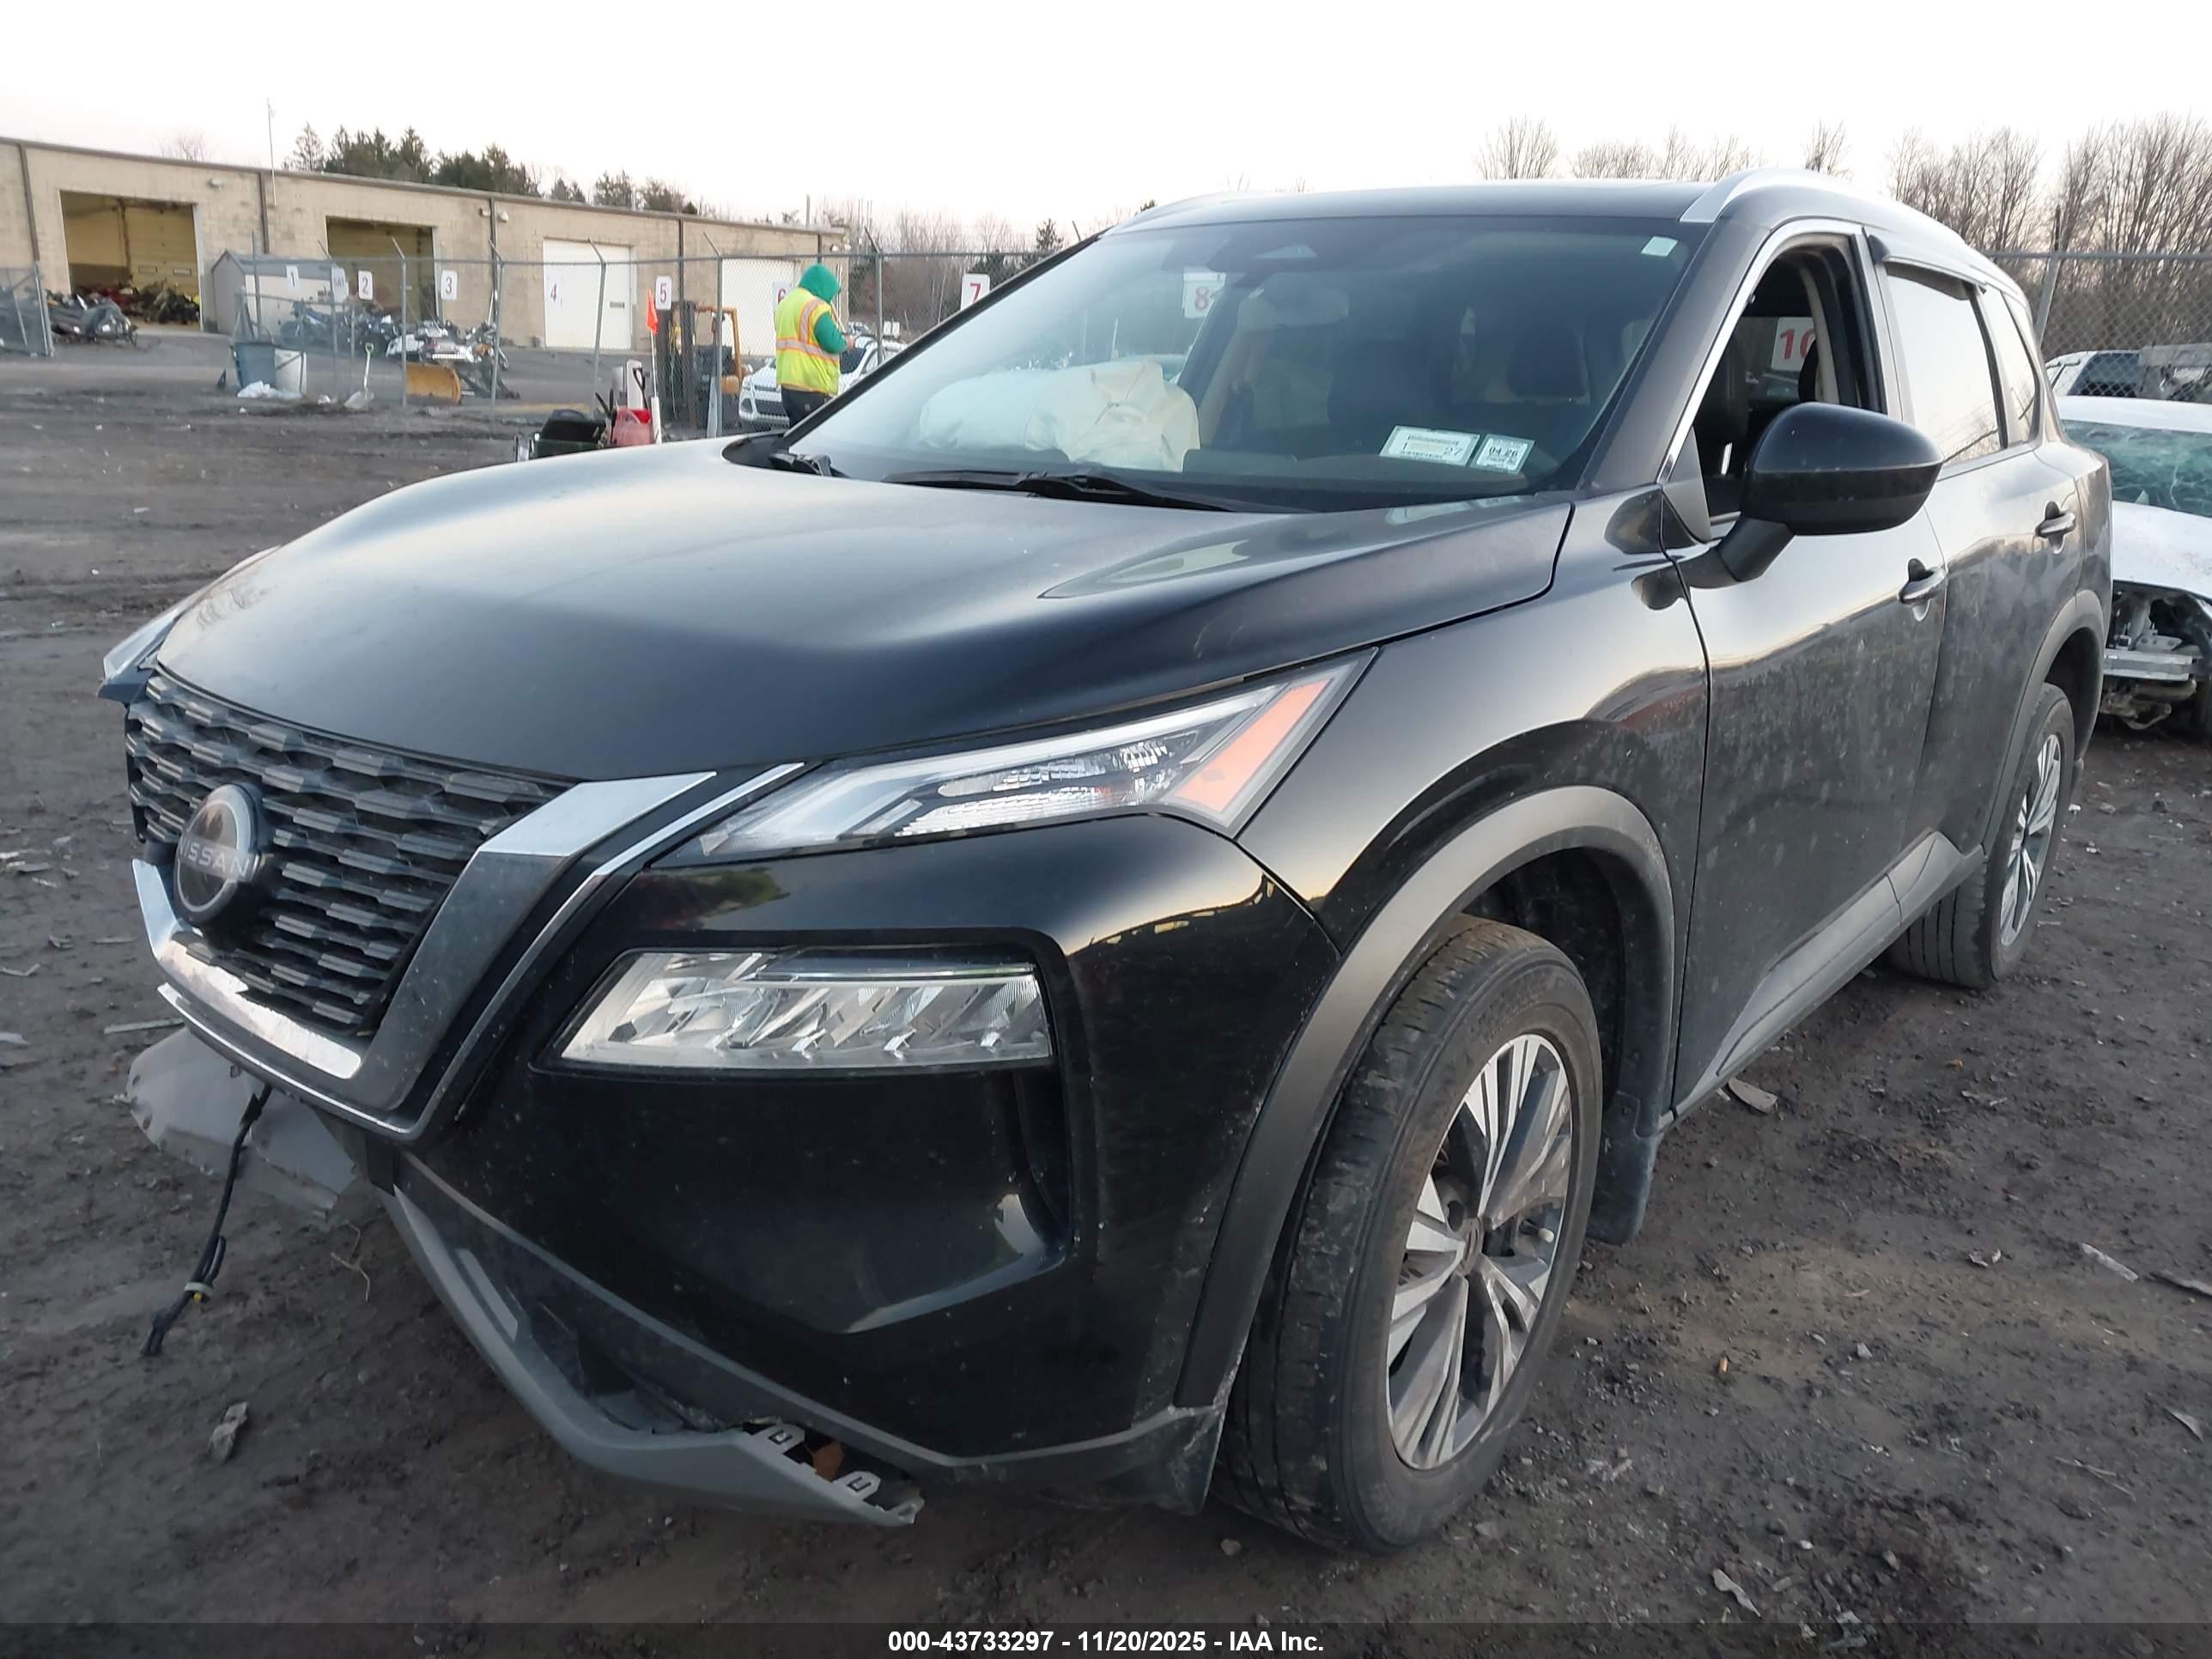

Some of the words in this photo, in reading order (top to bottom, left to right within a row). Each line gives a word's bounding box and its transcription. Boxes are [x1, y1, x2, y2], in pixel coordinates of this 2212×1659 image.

[289, 271, 295, 288] 1
[362, 276, 369, 295] 2
[445, 276, 453, 295] 3
[550, 283, 557, 303] 4
[659, 283, 667, 303] 5
[969, 283, 981, 303] 7
[1194, 286, 1210, 311] 8
[179, 836, 250, 876] NISSAN
